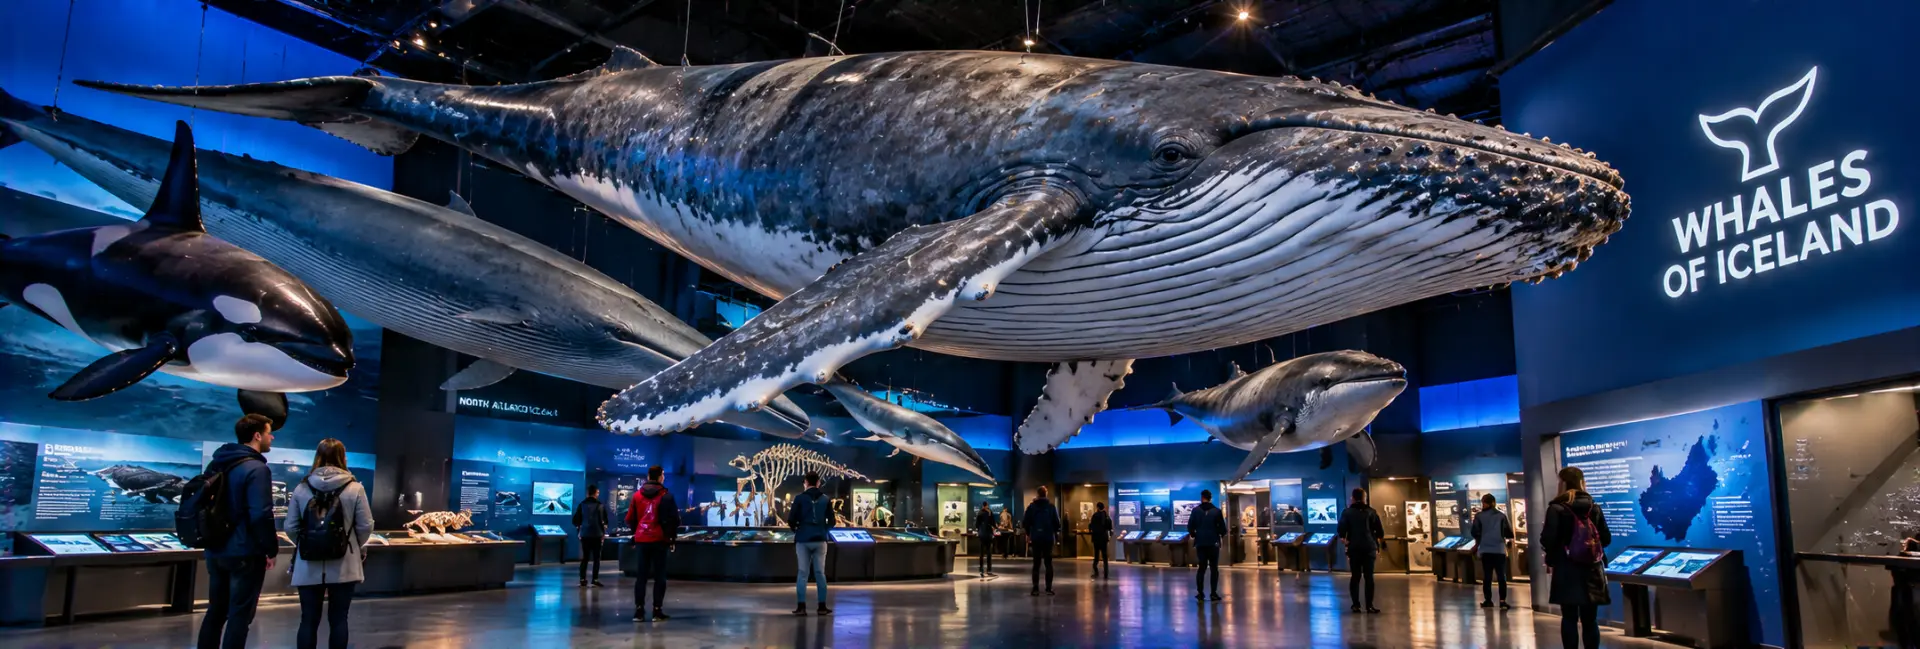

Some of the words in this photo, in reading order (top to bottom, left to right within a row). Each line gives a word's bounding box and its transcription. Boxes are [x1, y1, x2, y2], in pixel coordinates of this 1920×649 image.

[1663, 256, 1706, 298] OF
[1717, 199, 1900, 285] ICELAND
[1672, 149, 1871, 254] WHALES
